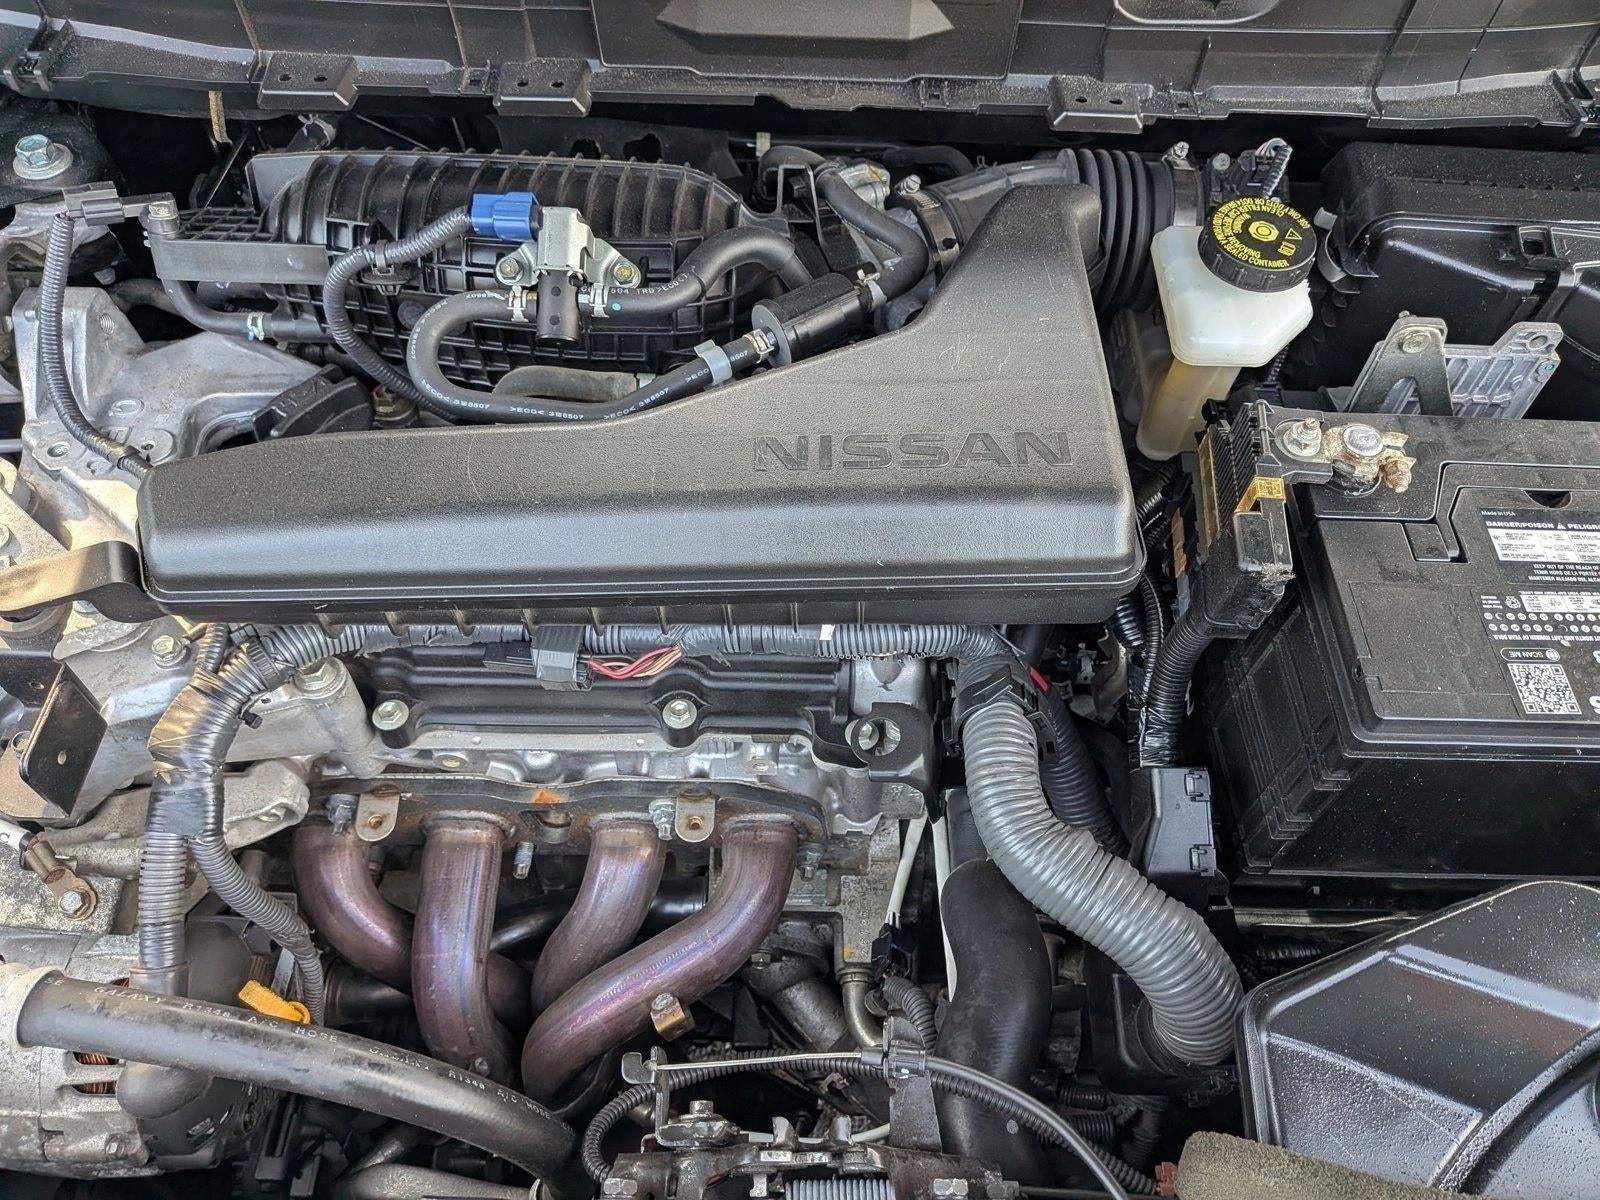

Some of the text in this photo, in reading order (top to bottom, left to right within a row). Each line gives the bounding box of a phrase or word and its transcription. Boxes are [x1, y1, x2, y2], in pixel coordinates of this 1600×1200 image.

[1262, 205, 1285, 217] CLEAN
[1284, 206, 1301, 220] ONLY
[1224, 243, 1249, 261] SEALED
[1227, 235, 1261, 258] REMOVING
[1249, 256, 1289, 268] CONTAINER
[753, 431, 1073, 471] NISSAN
[1485, 521, 1555, 529] DANGER/POISON
[248, 1016, 279, 1028] A/C
[295, 1026, 338, 1043] HOSE
